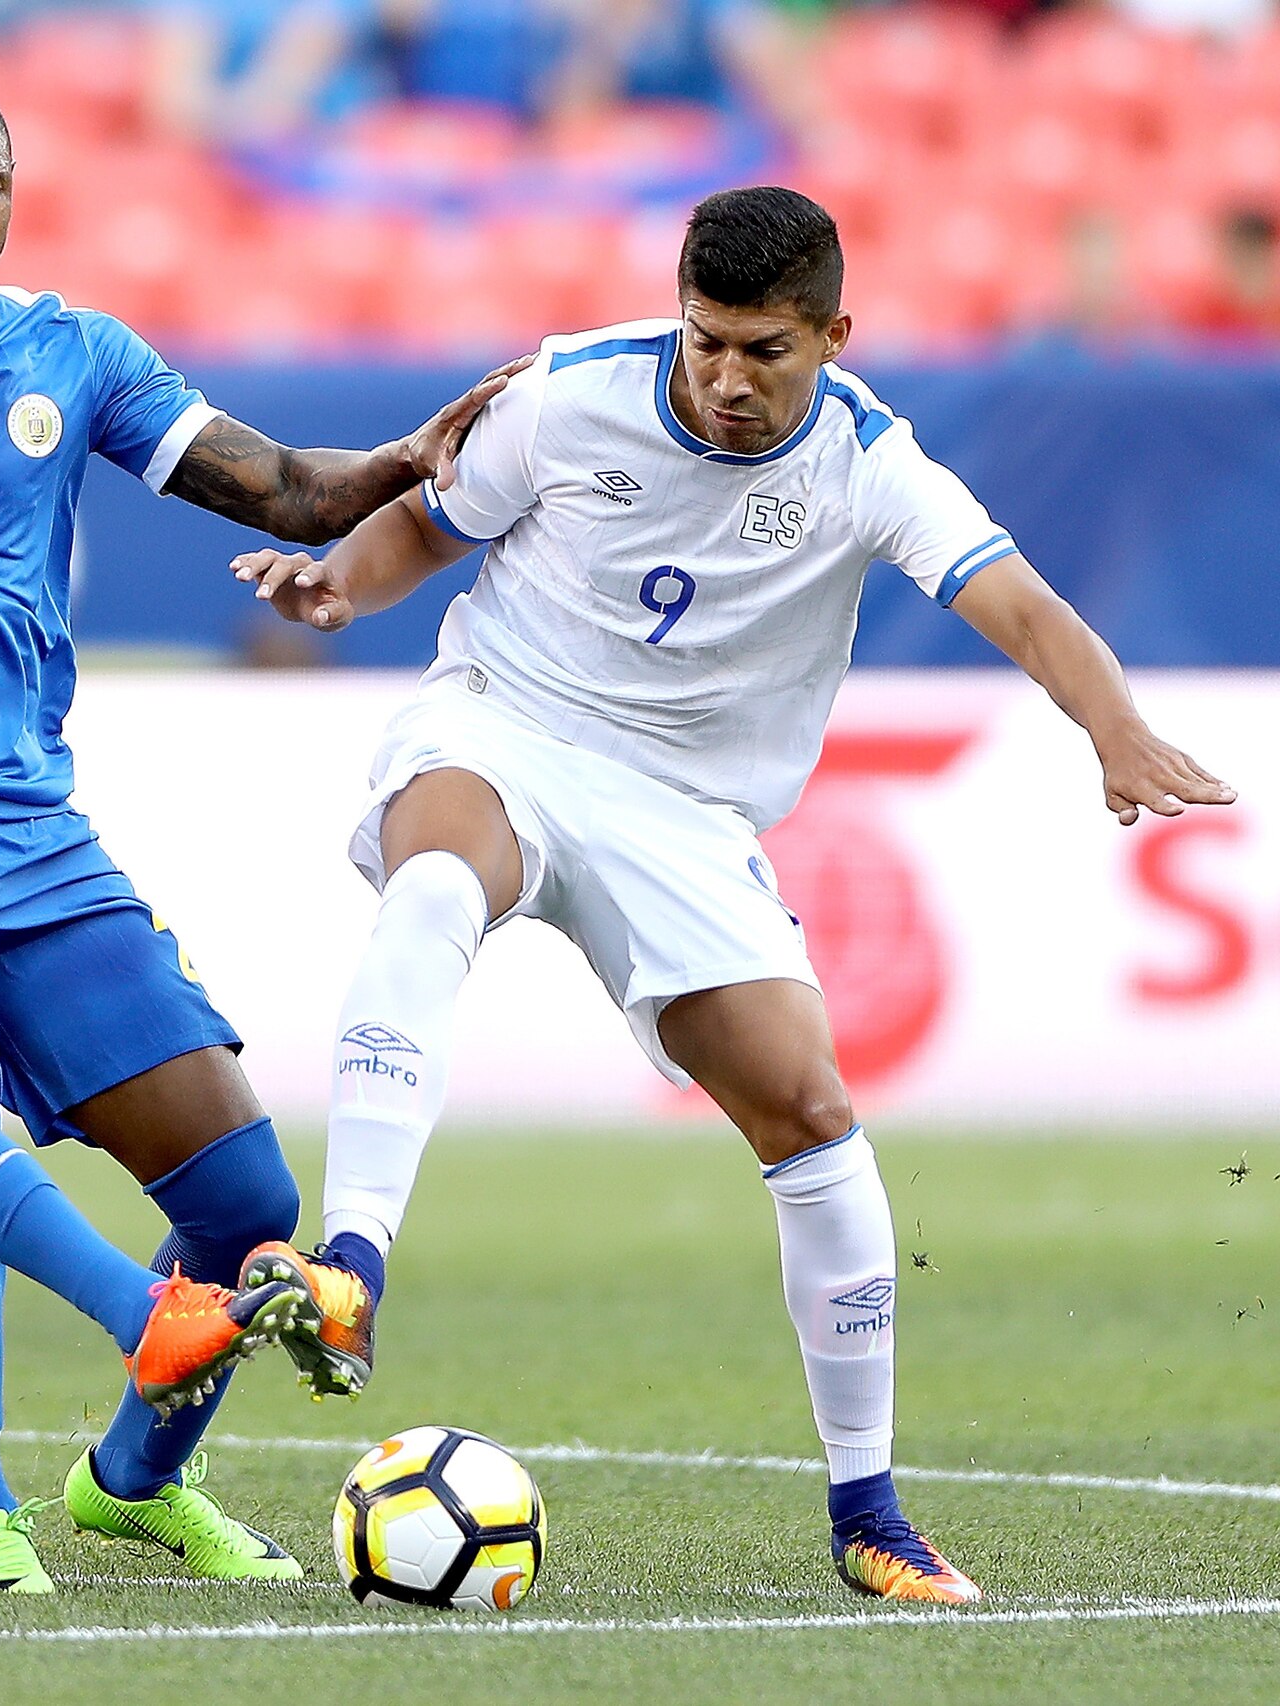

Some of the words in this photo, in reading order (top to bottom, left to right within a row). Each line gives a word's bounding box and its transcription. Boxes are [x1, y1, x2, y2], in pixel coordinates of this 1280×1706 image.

[591, 487, 633, 507] umbro
[740, 493, 807, 549] ES
[639, 565, 697, 645] 9
[338, 1053, 418, 1087] umbro
